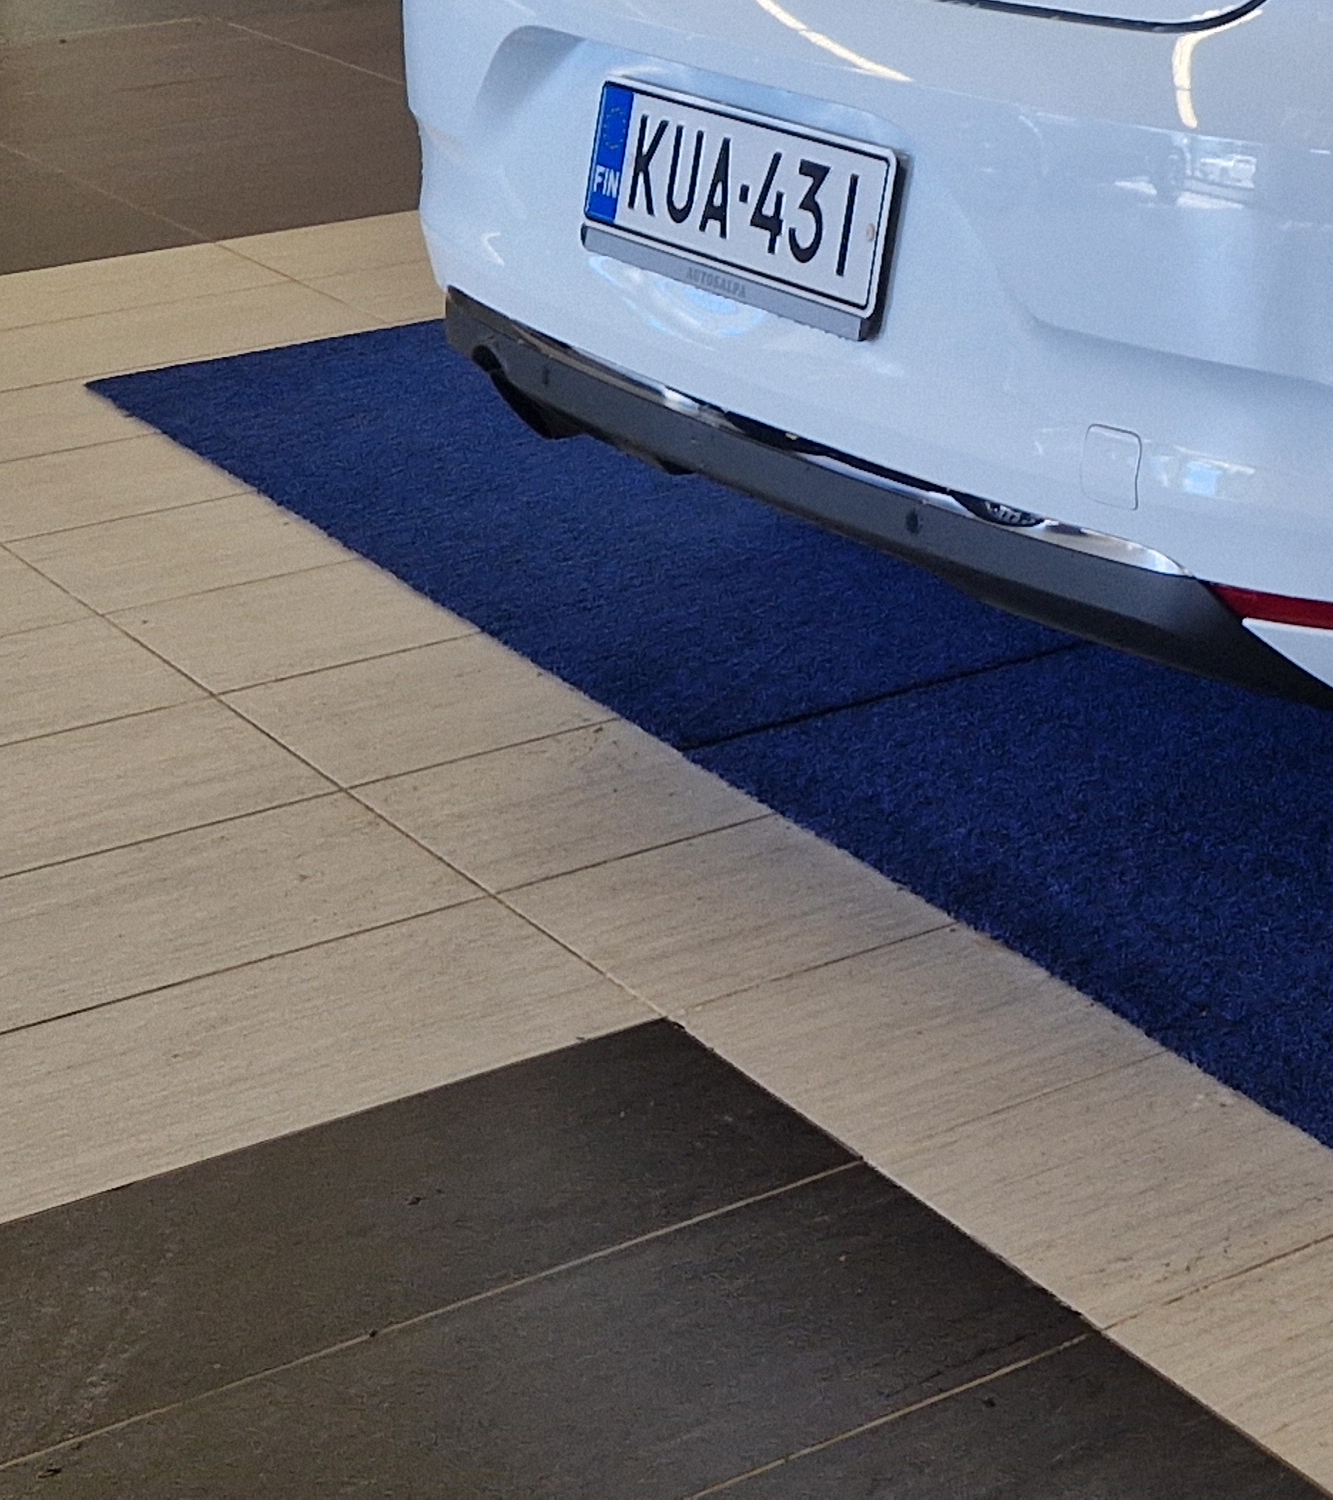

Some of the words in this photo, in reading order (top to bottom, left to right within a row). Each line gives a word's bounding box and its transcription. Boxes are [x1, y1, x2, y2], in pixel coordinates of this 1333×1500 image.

[593, 165, 620, 199] FIN
[627, 113, 859, 276] KUA-431
[685, 267, 746, 298] AUTOSALPA
